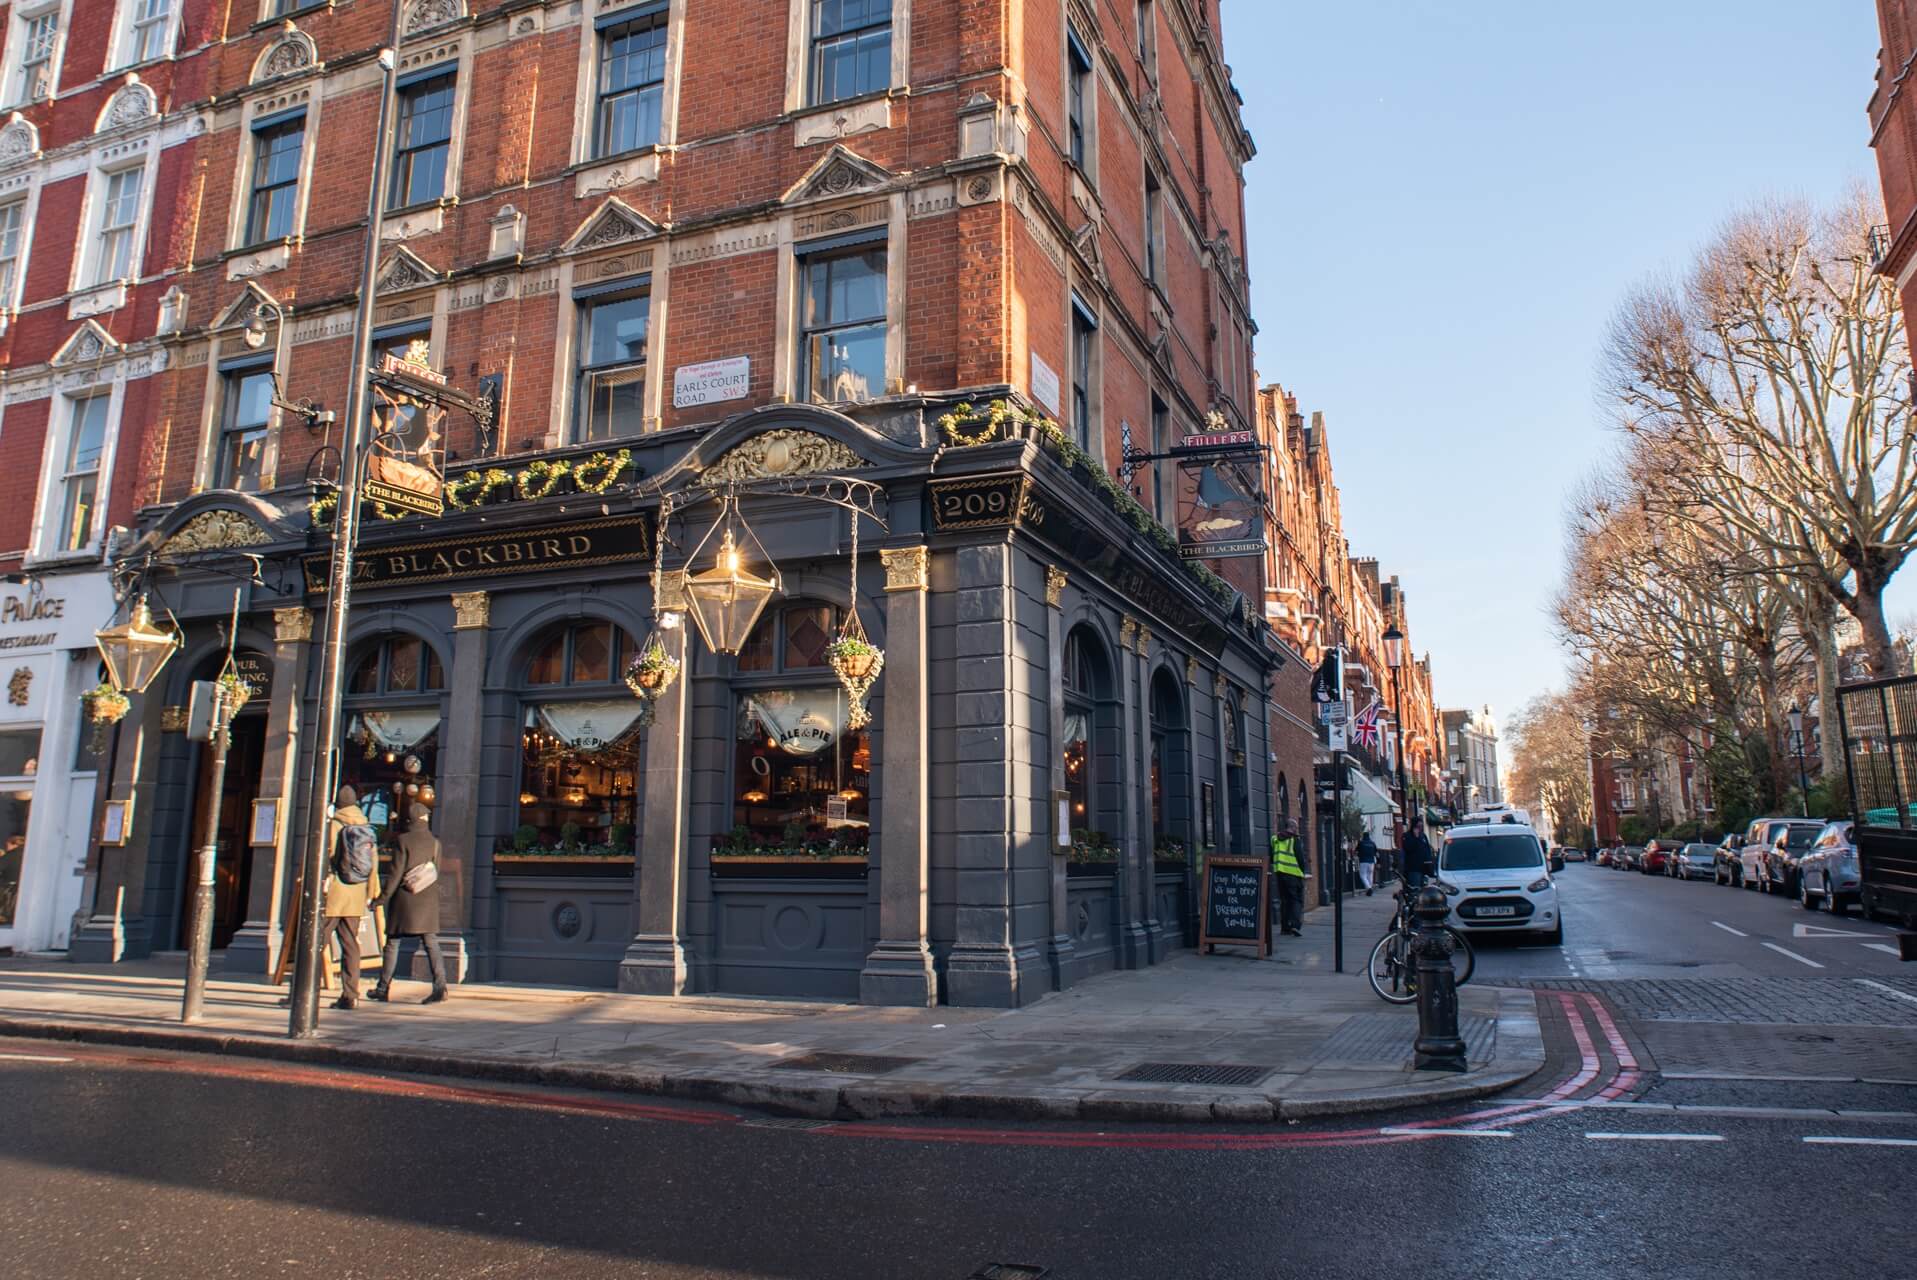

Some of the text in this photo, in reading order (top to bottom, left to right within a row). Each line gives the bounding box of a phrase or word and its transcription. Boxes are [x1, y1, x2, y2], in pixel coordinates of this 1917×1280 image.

[676, 374, 746, 394] EARLS COURT
[676, 392, 706, 406] ROAD
[370, 485, 439, 511] THE BLACKBIRD
[944, 491, 1005, 516] 209
[1020, 495, 1045, 526] 209
[389, 535, 592, 575] BLACKBIRD
[1183, 543, 1260, 555] THE BLACKBIRD
[780, 727, 831, 744] ALE & PIE
